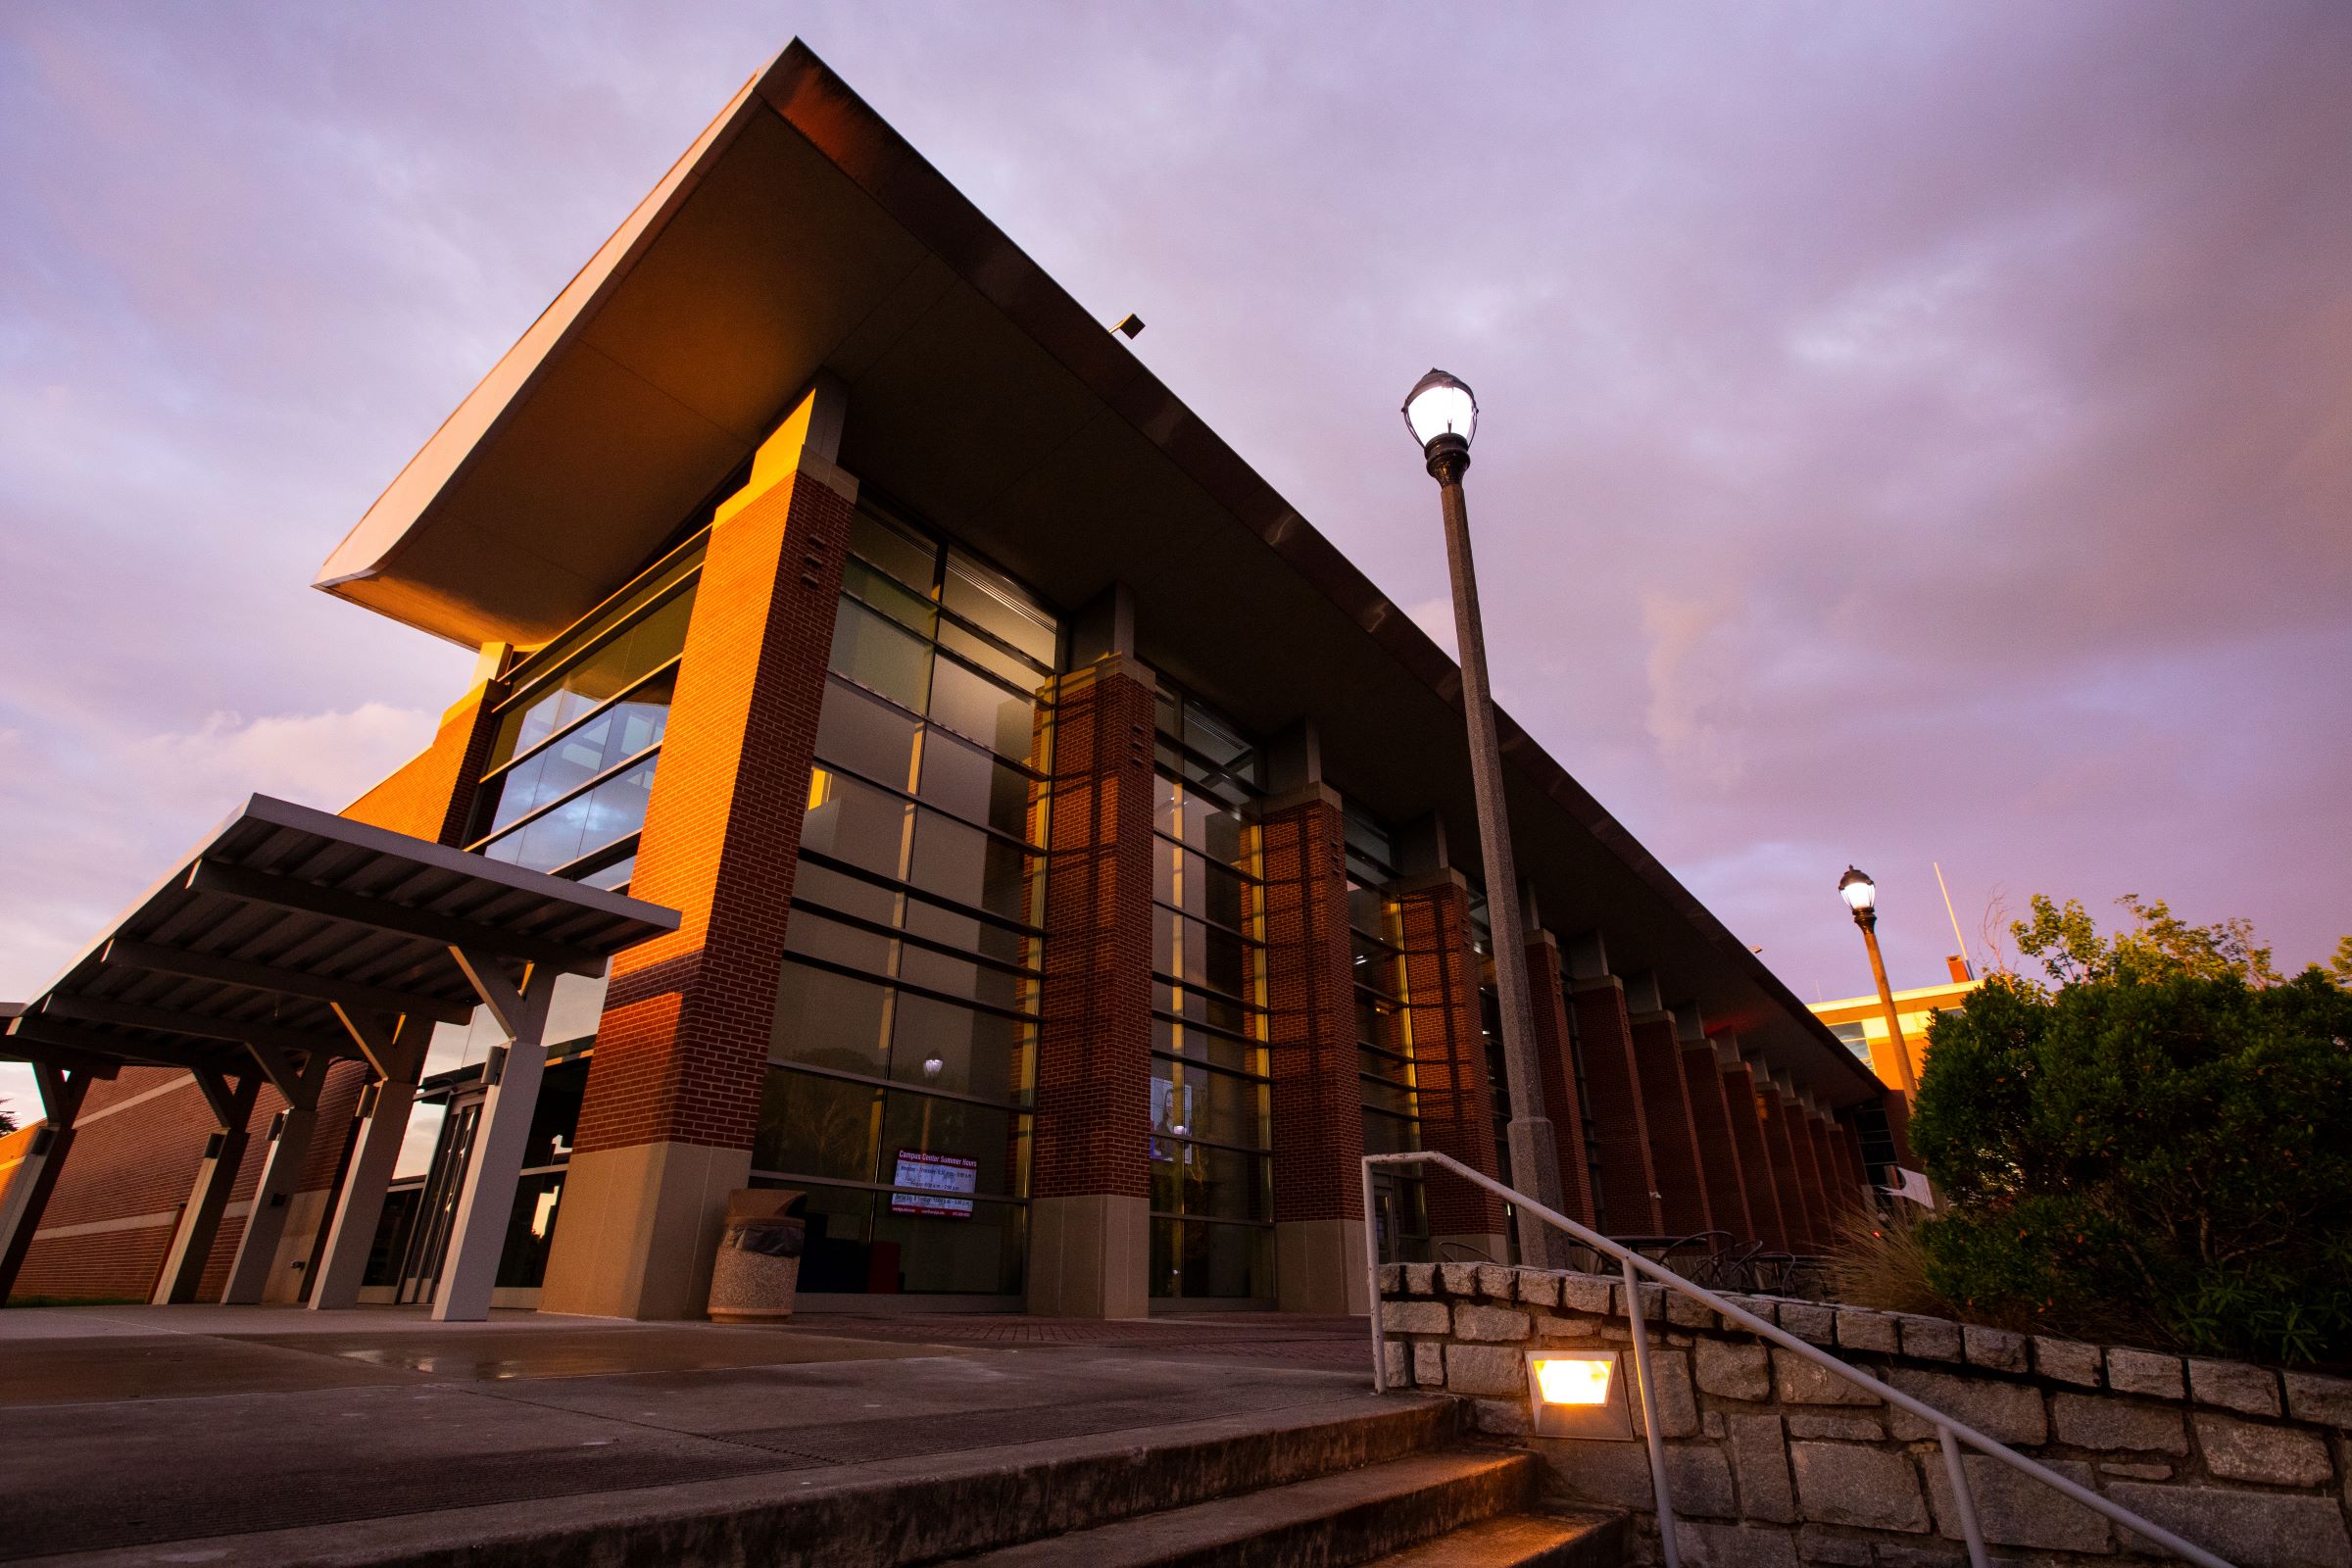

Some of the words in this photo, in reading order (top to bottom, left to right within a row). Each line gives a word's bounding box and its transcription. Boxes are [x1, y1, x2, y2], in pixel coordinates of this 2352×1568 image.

[899, 1150, 921, 1160] Campus
[922, 1152, 940, 1162] Center
[941, 1155, 962, 1165] Summer
